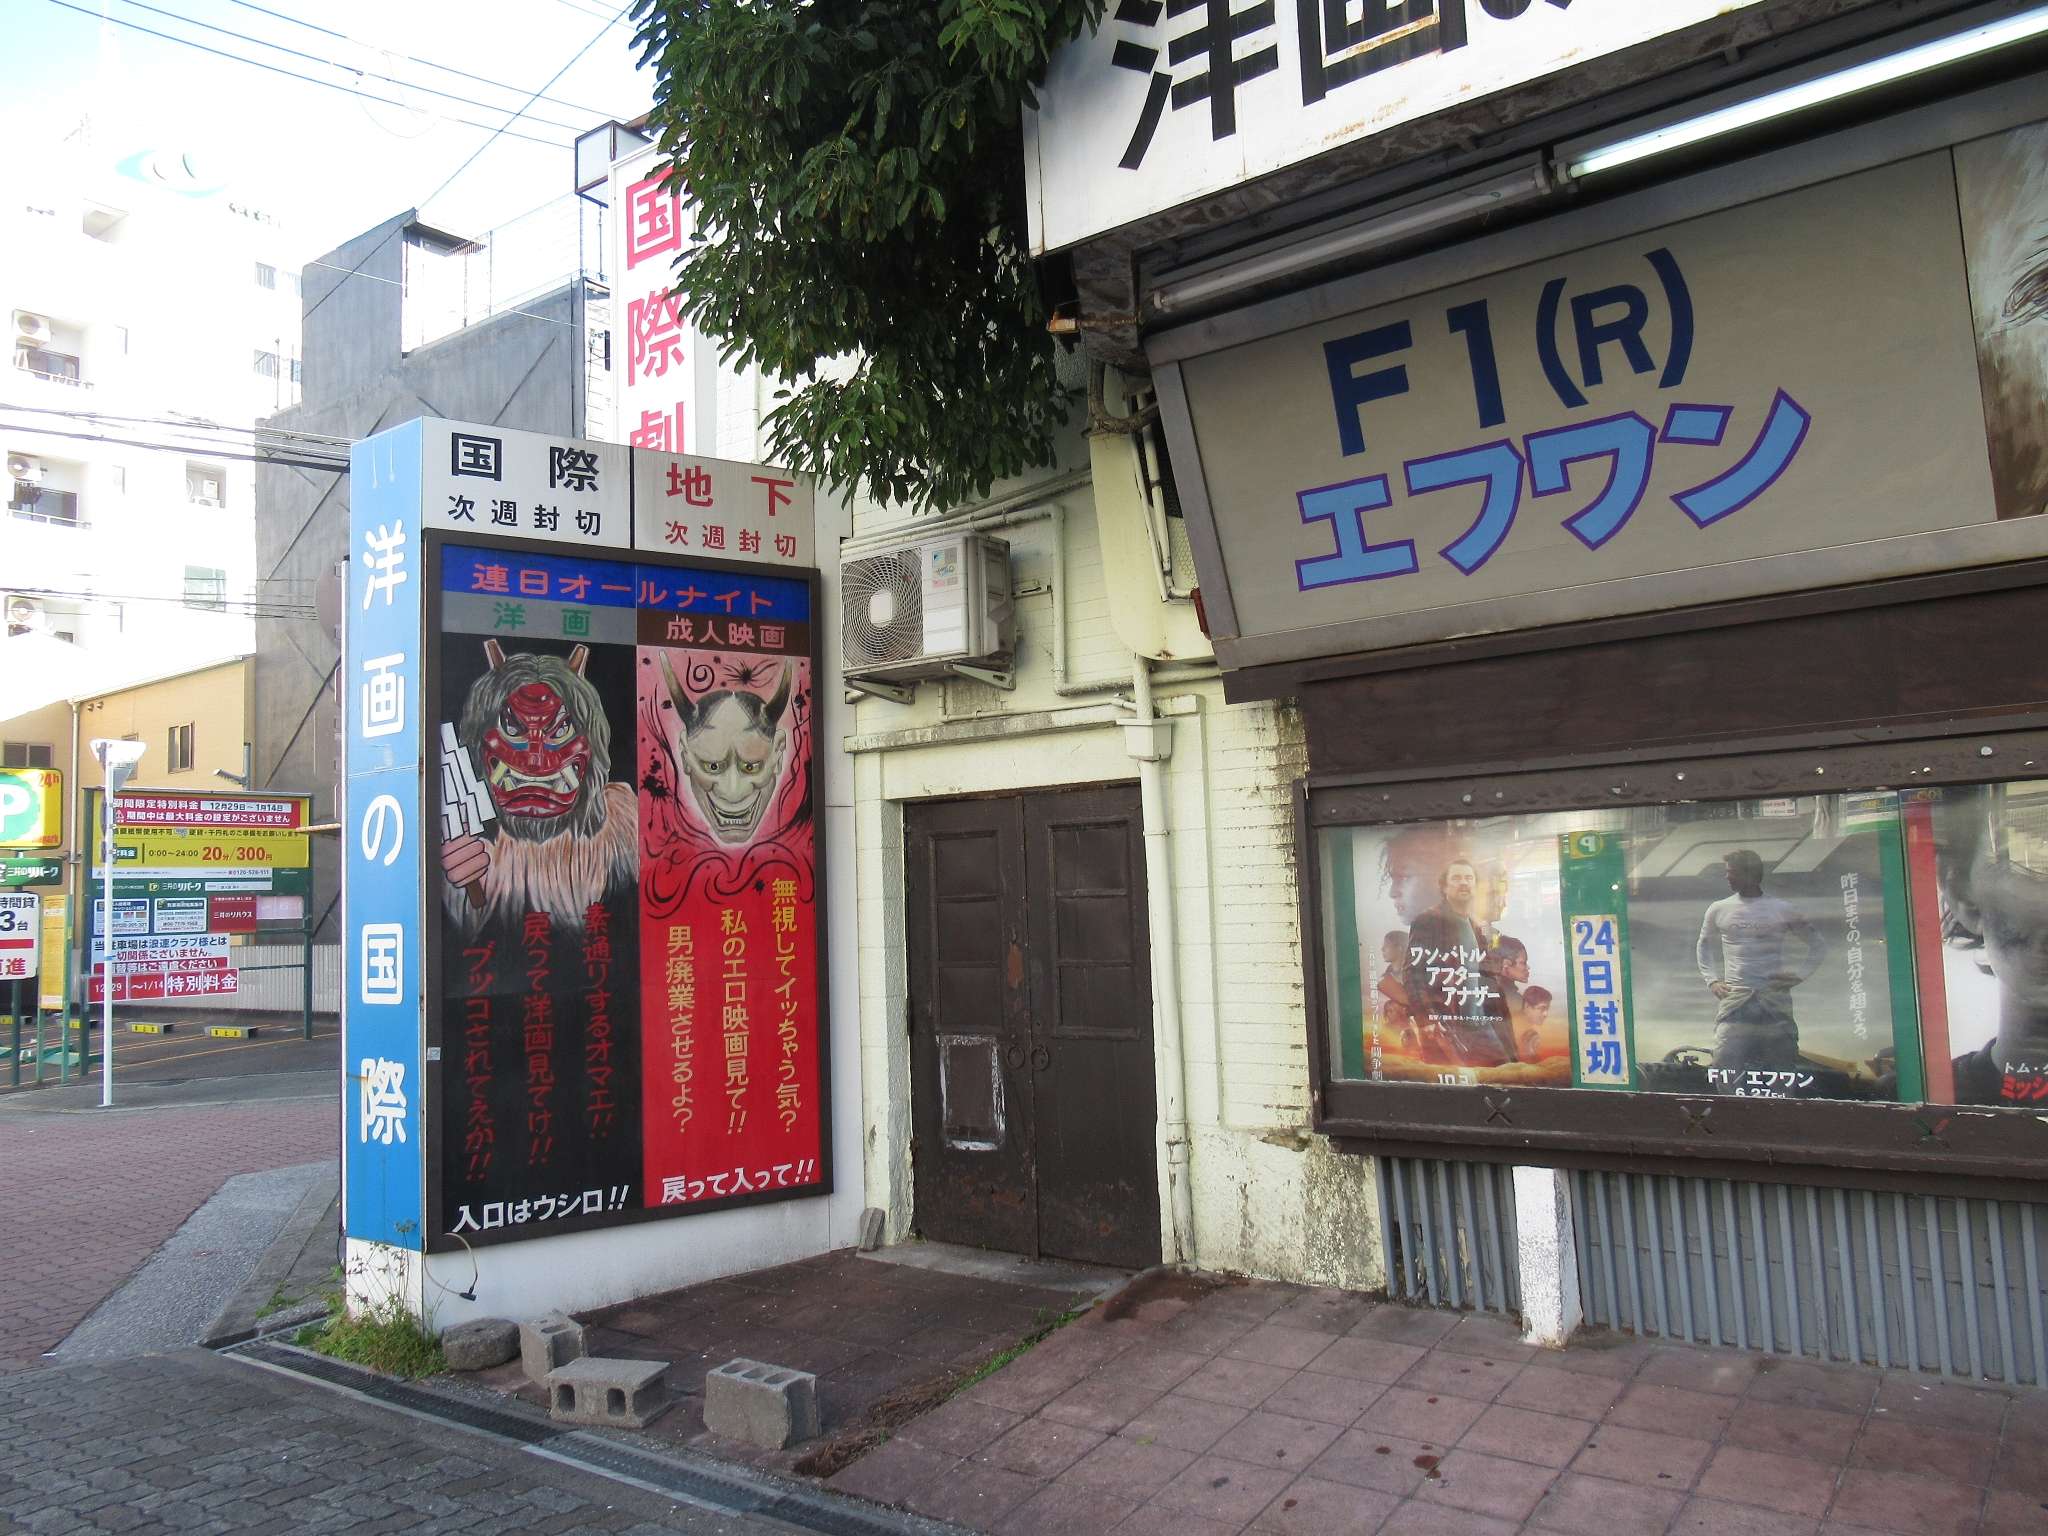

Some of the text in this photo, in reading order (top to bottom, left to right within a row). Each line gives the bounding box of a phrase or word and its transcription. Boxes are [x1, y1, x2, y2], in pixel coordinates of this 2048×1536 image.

[451, 432, 599, 492] 国際
[666, 462, 795, 516] 地下
[1295, 387, 1811, 592] エフワン
[447, 494, 601, 536] 次週封切
[665, 520, 797, 559] 次週封切
[472, 563, 774, 616] 連日オールナイト
[493, 602, 591, 637] 洋画
[665, 613, 786, 649] 成人映画
[361, 519, 409, 1145] 洋画の国際
[0, 957, 26, 976] 進
[167, 973, 238, 994] 特別料金
[1425, 966, 1481, 986] アフター
[1441, 985, 1501, 1007] アナザー
[1575, 919, 1622, 1076] 24日封切
